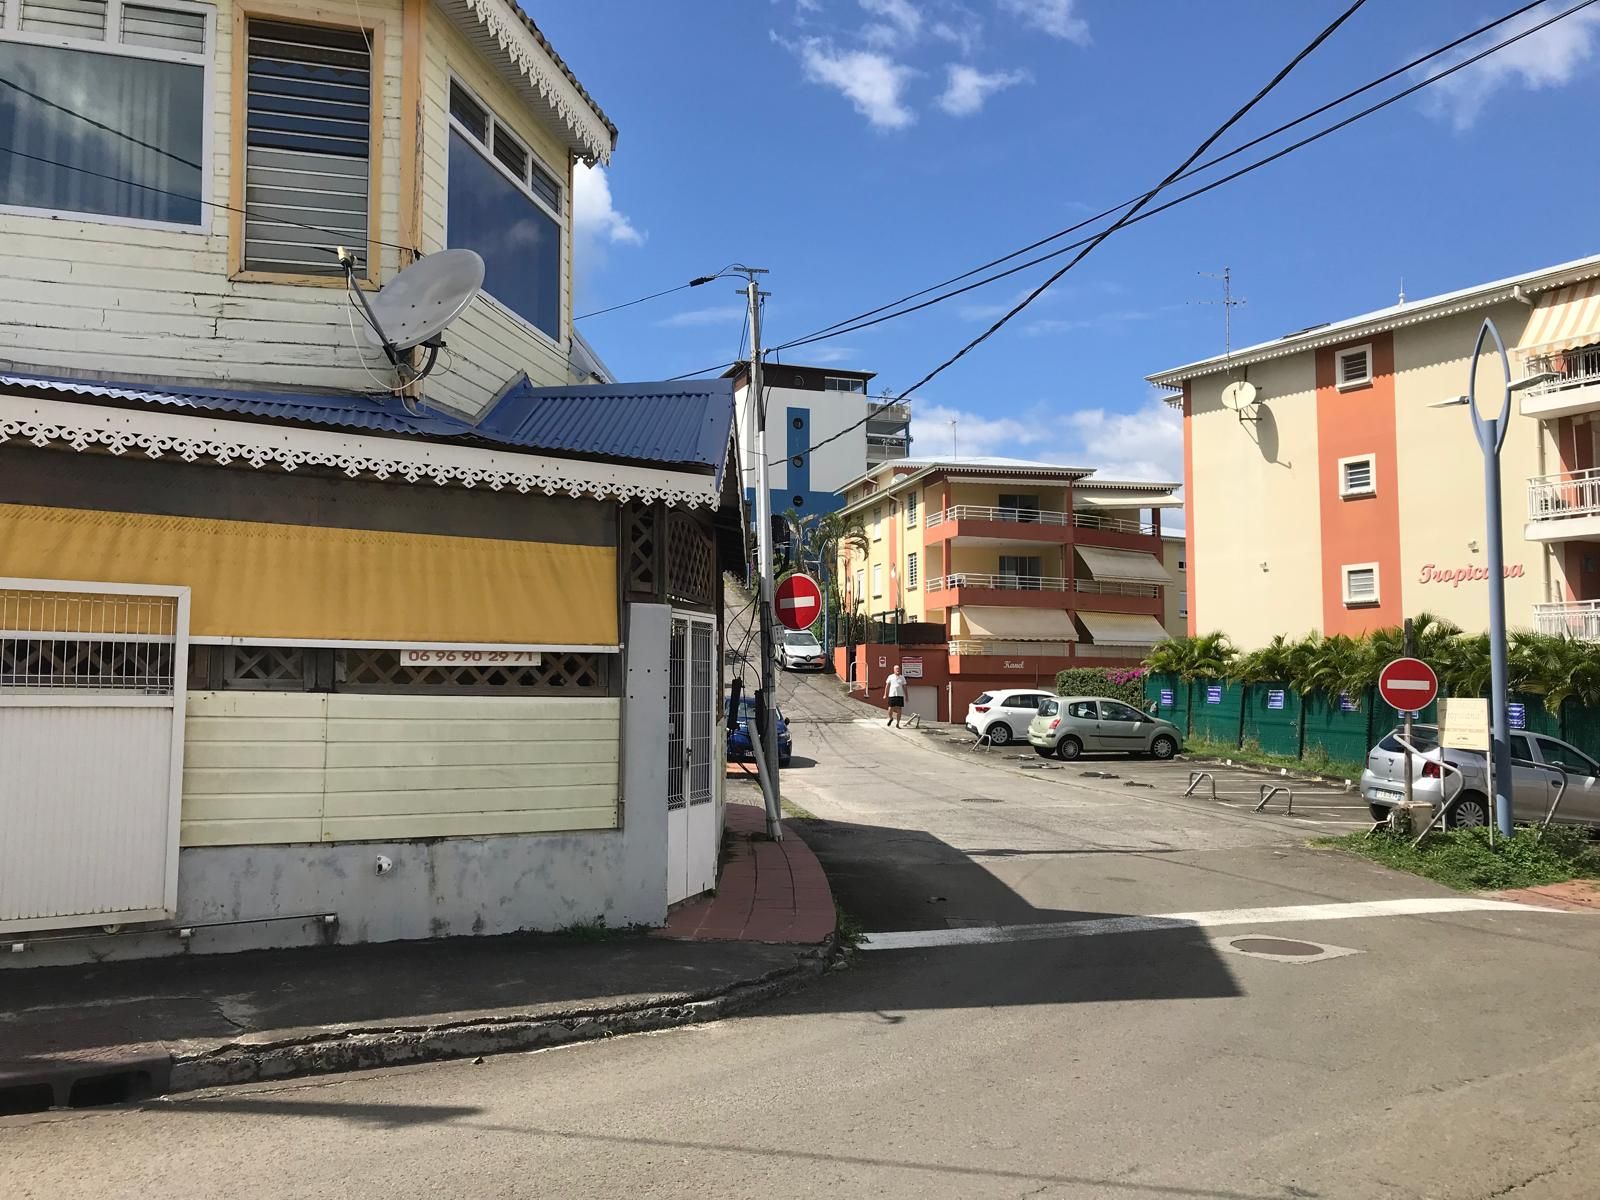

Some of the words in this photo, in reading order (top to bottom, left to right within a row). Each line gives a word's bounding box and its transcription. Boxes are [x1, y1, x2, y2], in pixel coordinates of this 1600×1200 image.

[408, 651, 430, 662] 06
[435, 651, 456, 662] 96
[462, 651, 482, 662] 90
[488, 651, 509, 662] 29
[514, 651, 533, 661] 71
